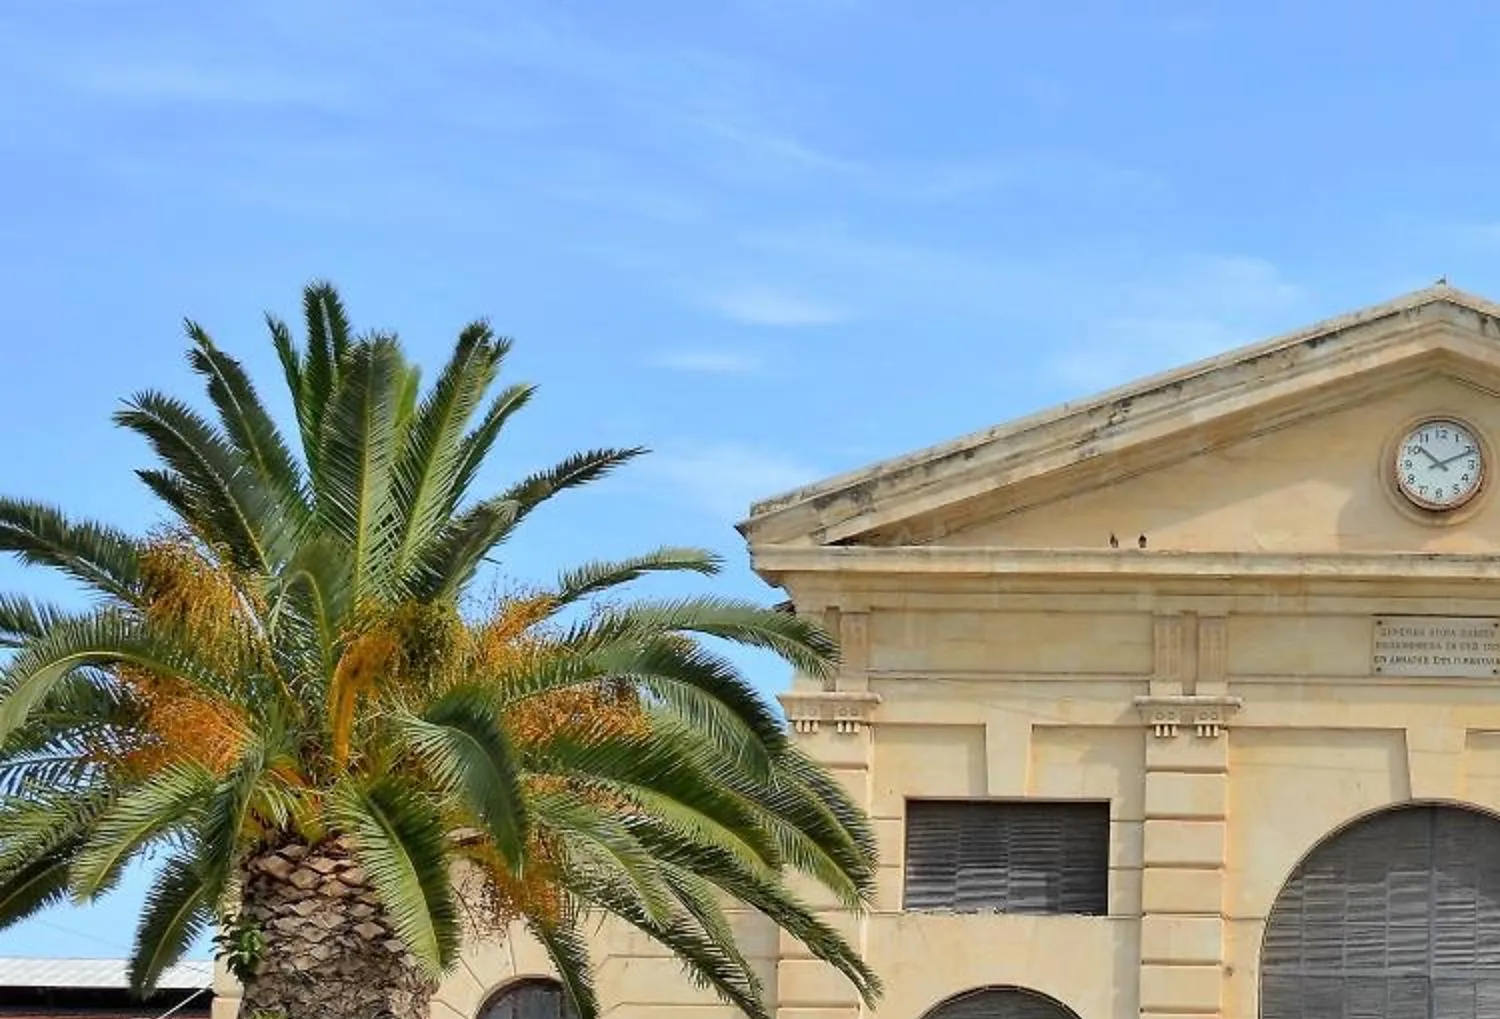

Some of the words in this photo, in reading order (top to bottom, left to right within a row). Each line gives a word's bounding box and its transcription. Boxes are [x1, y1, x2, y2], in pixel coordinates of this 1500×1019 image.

[1419, 432, 1429, 443] 11
[1436, 428, 1448, 439] 12
[1407, 445, 1420, 455] 10
[1404, 459, 1412, 469] 9
[1467, 459, 1475, 470] 3
[1408, 474, 1415, 485] 8
[1461, 473, 1469, 482] 4
[1435, 488, 1443, 498] 6
[1452, 484, 1460, 494] 5
